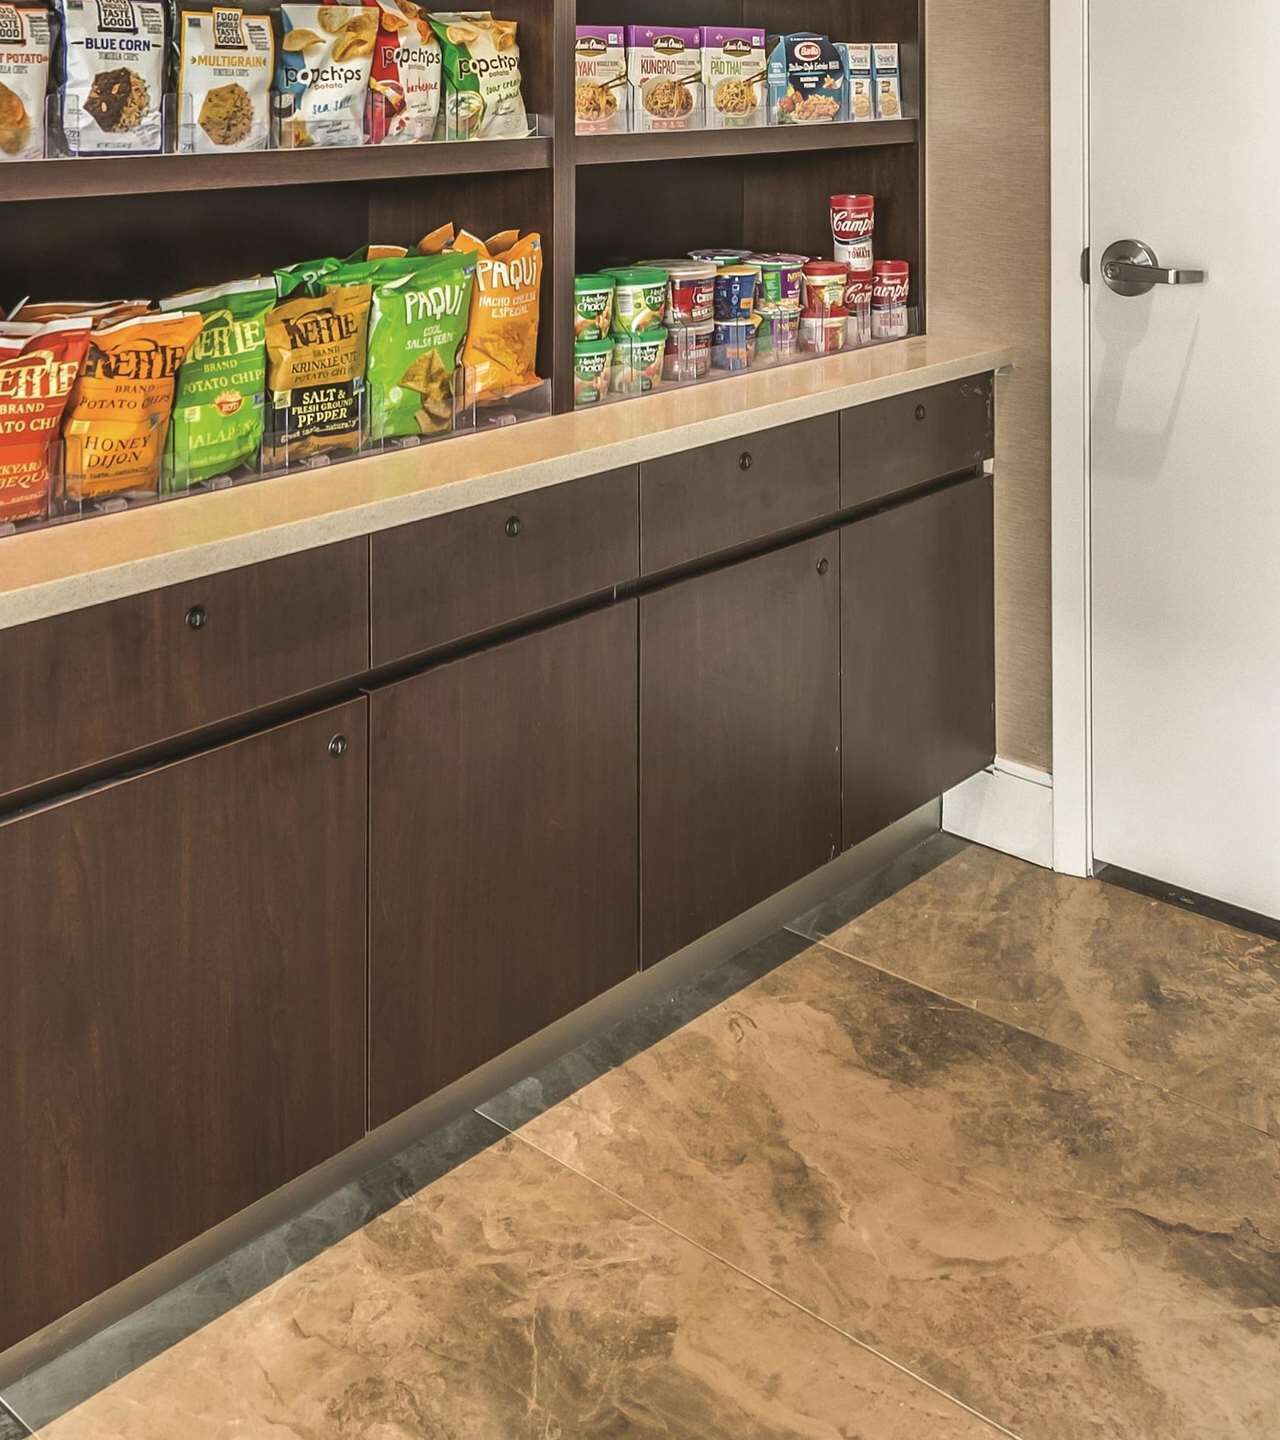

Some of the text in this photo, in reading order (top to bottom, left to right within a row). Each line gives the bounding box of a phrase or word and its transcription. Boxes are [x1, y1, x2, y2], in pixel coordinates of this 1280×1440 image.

[102, 9, 133, 18] TASTE
[216, 12, 240, 22] FOOD
[103, 17, 132, 28] GOOD
[85, 38, 151, 51] BLUE CORN
[217, 34, 242, 45] GOOD
[6, 53, 43, 64] POTATO
[197, 55, 263, 67] MULTIGRAIN
[382, 47, 440, 68] popchips
[284, 66, 361, 88] popchips
[114, 384, 156, 392] BRAND
[302, 388, 336, 404] SALT
[297, 408, 348, 428] PEPPER
[84, 435, 153, 452] HONEY
[88, 450, 142, 468] DIJON
